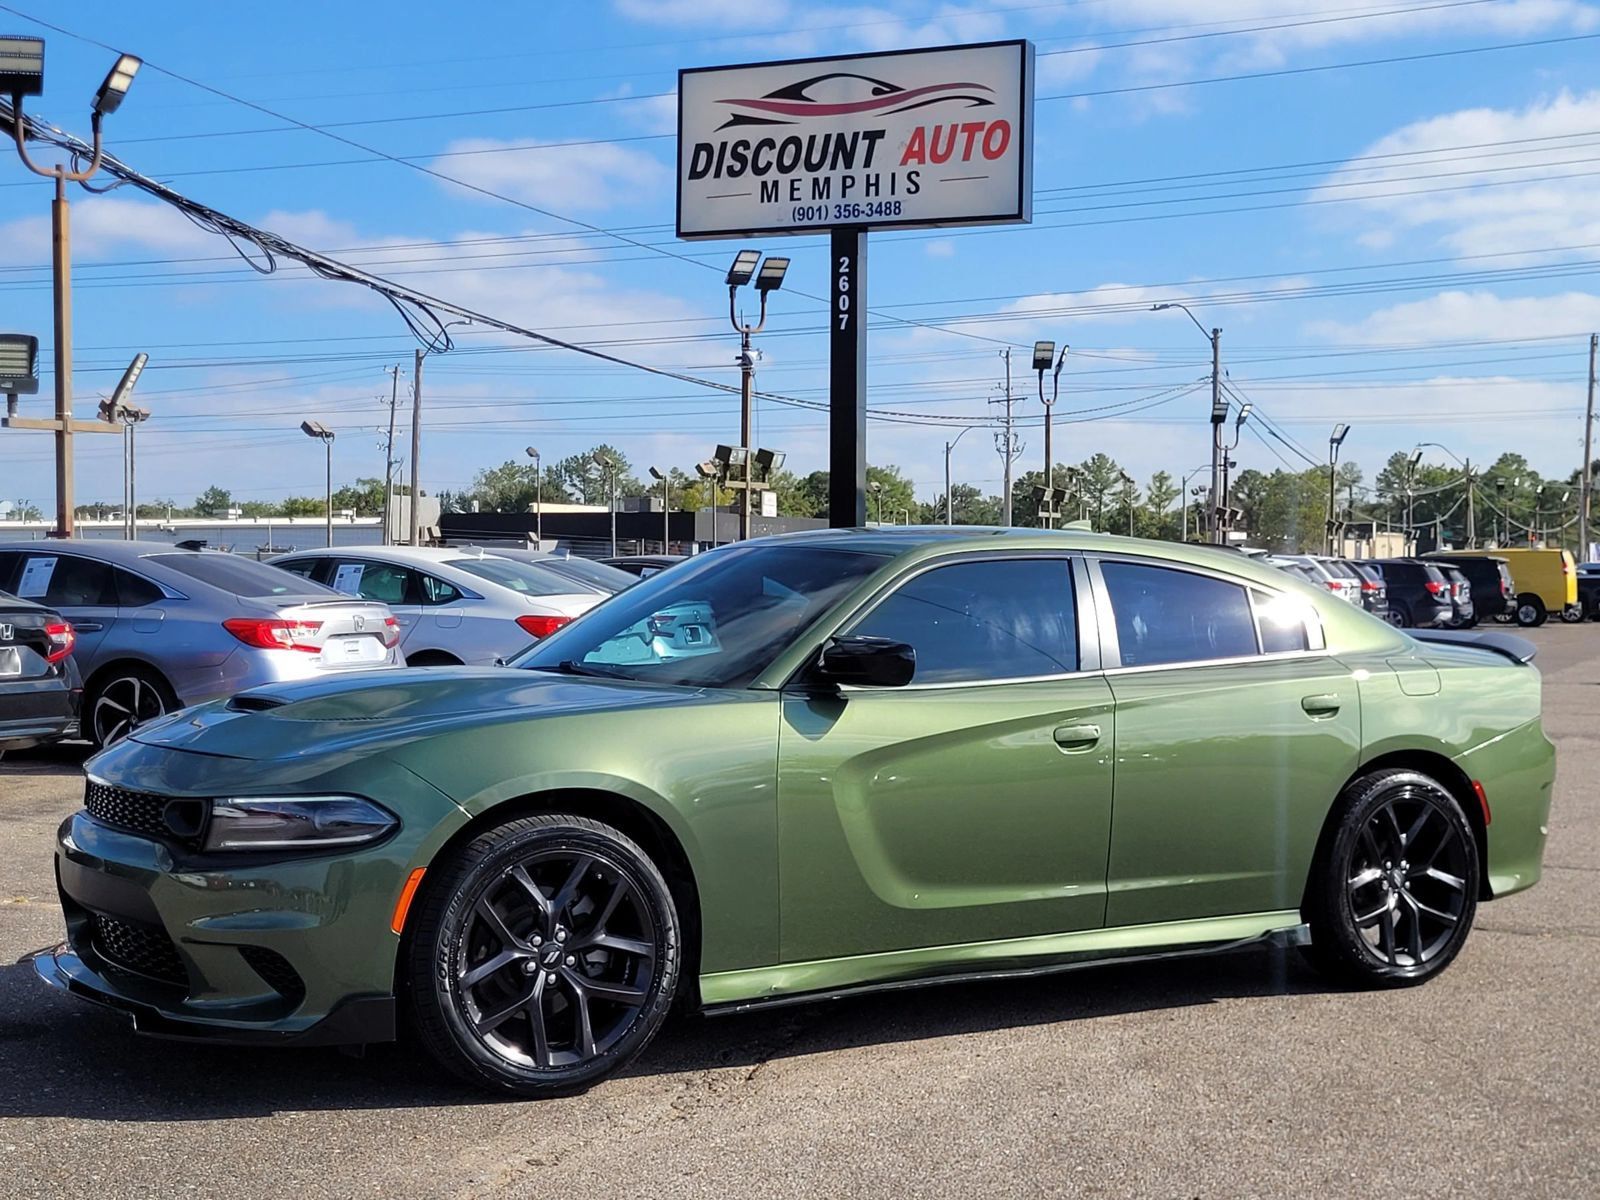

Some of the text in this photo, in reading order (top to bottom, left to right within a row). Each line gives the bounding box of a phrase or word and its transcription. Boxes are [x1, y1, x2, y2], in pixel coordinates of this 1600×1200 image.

[688, 119, 1011, 180] DISCOUNT AUTO
[760, 170, 921, 203] MEMPHIS
[792, 200, 902, 222] (901) 356-3488
[838, 256, 850, 330] 2607
[437, 918, 453, 994] FORCE
